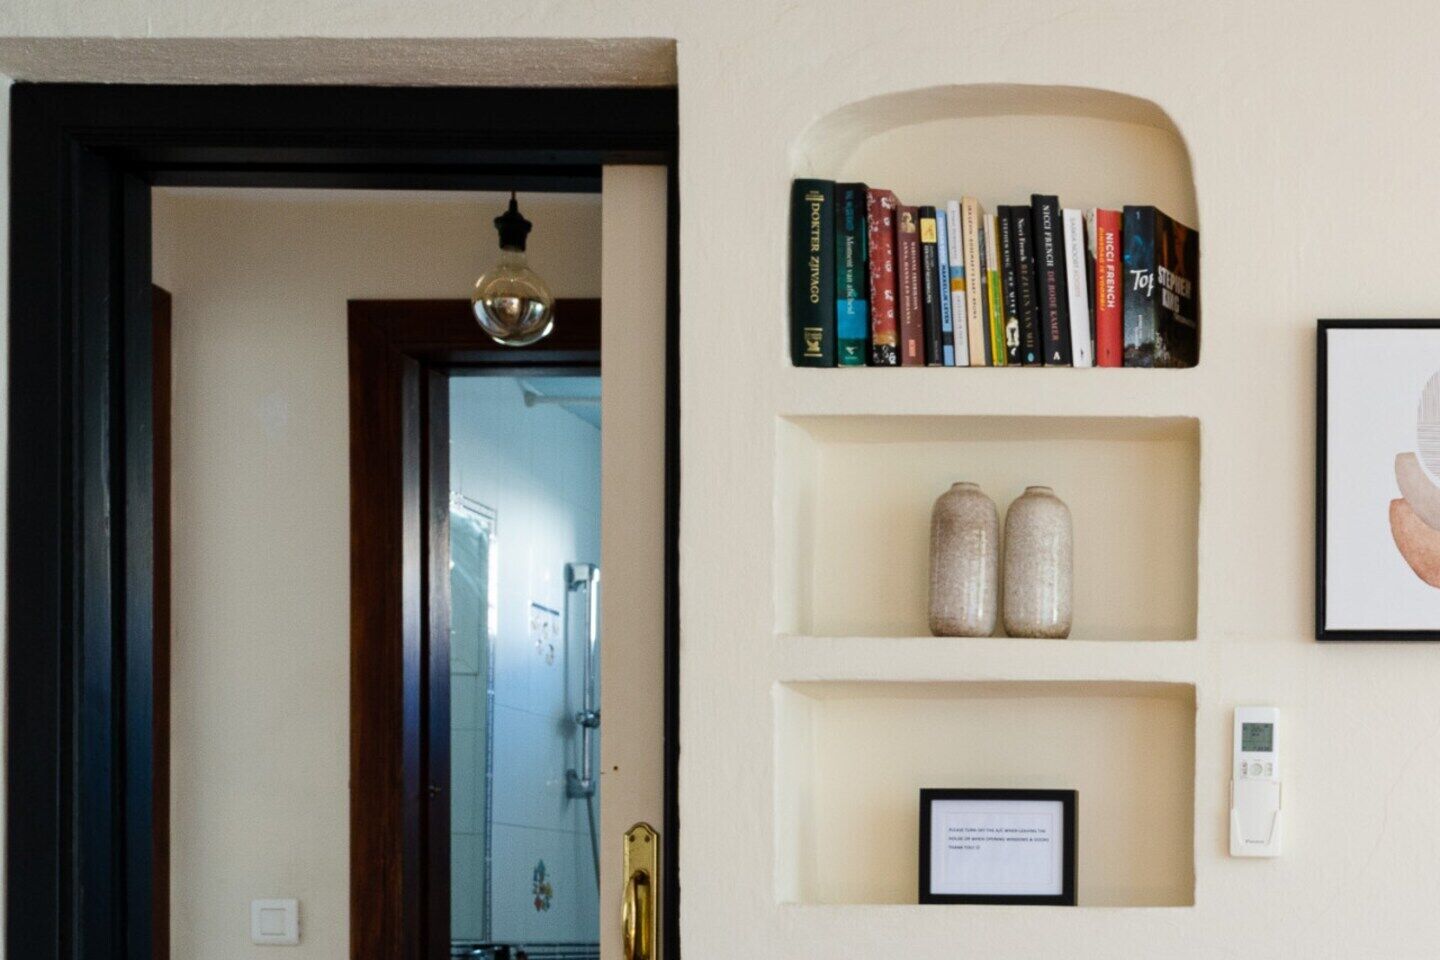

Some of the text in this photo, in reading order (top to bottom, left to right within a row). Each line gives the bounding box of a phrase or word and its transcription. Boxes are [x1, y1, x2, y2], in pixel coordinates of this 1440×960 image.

[1017, 218, 1026, 237] Nicci
[808, 203, 821, 304] DOKTER ZJIVAGO
[845, 235, 855, 267] Moment
[1018, 238, 1027, 262] French
[846, 269, 854, 283] van
[1042, 204, 1061, 342] NICCI FRENCH DE RODE KAMER
[1105, 232, 1116, 308] NICCI FRENCH
[1158, 265, 1192, 300] STEPHEN
[943, 302, 951, 324] LEVEN
[1162, 287, 1181, 314] KING
